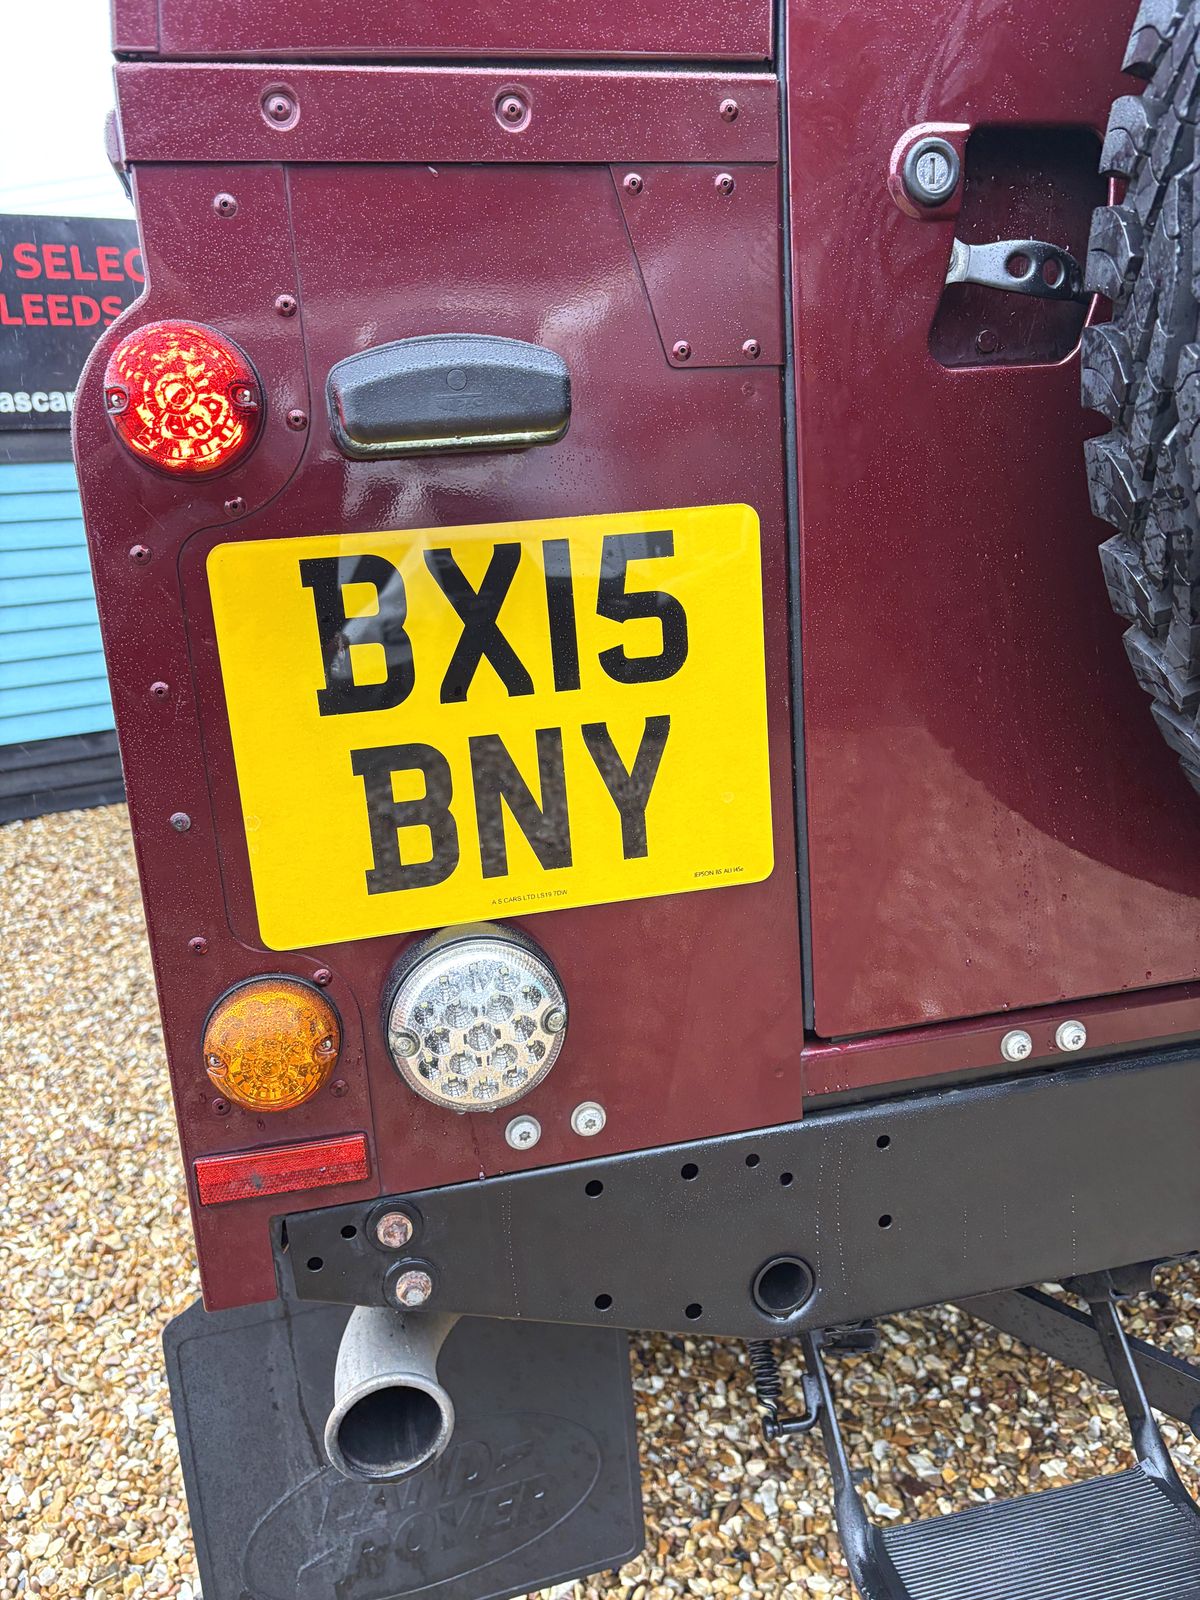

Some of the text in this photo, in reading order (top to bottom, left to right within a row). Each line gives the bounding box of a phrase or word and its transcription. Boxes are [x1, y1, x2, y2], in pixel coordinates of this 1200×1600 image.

[13, 242, 146, 283] SELEC
[0, 293, 124, 327] LEEDS
[299, 529, 689, 717] BX15
[349, 714, 671, 896] BNY
[503, 895, 522, 904] CARS
[522, 893, 536, 901] LTD
[536, 891, 552, 899] LS19
[336, 1471, 558, 1592] ROVER
